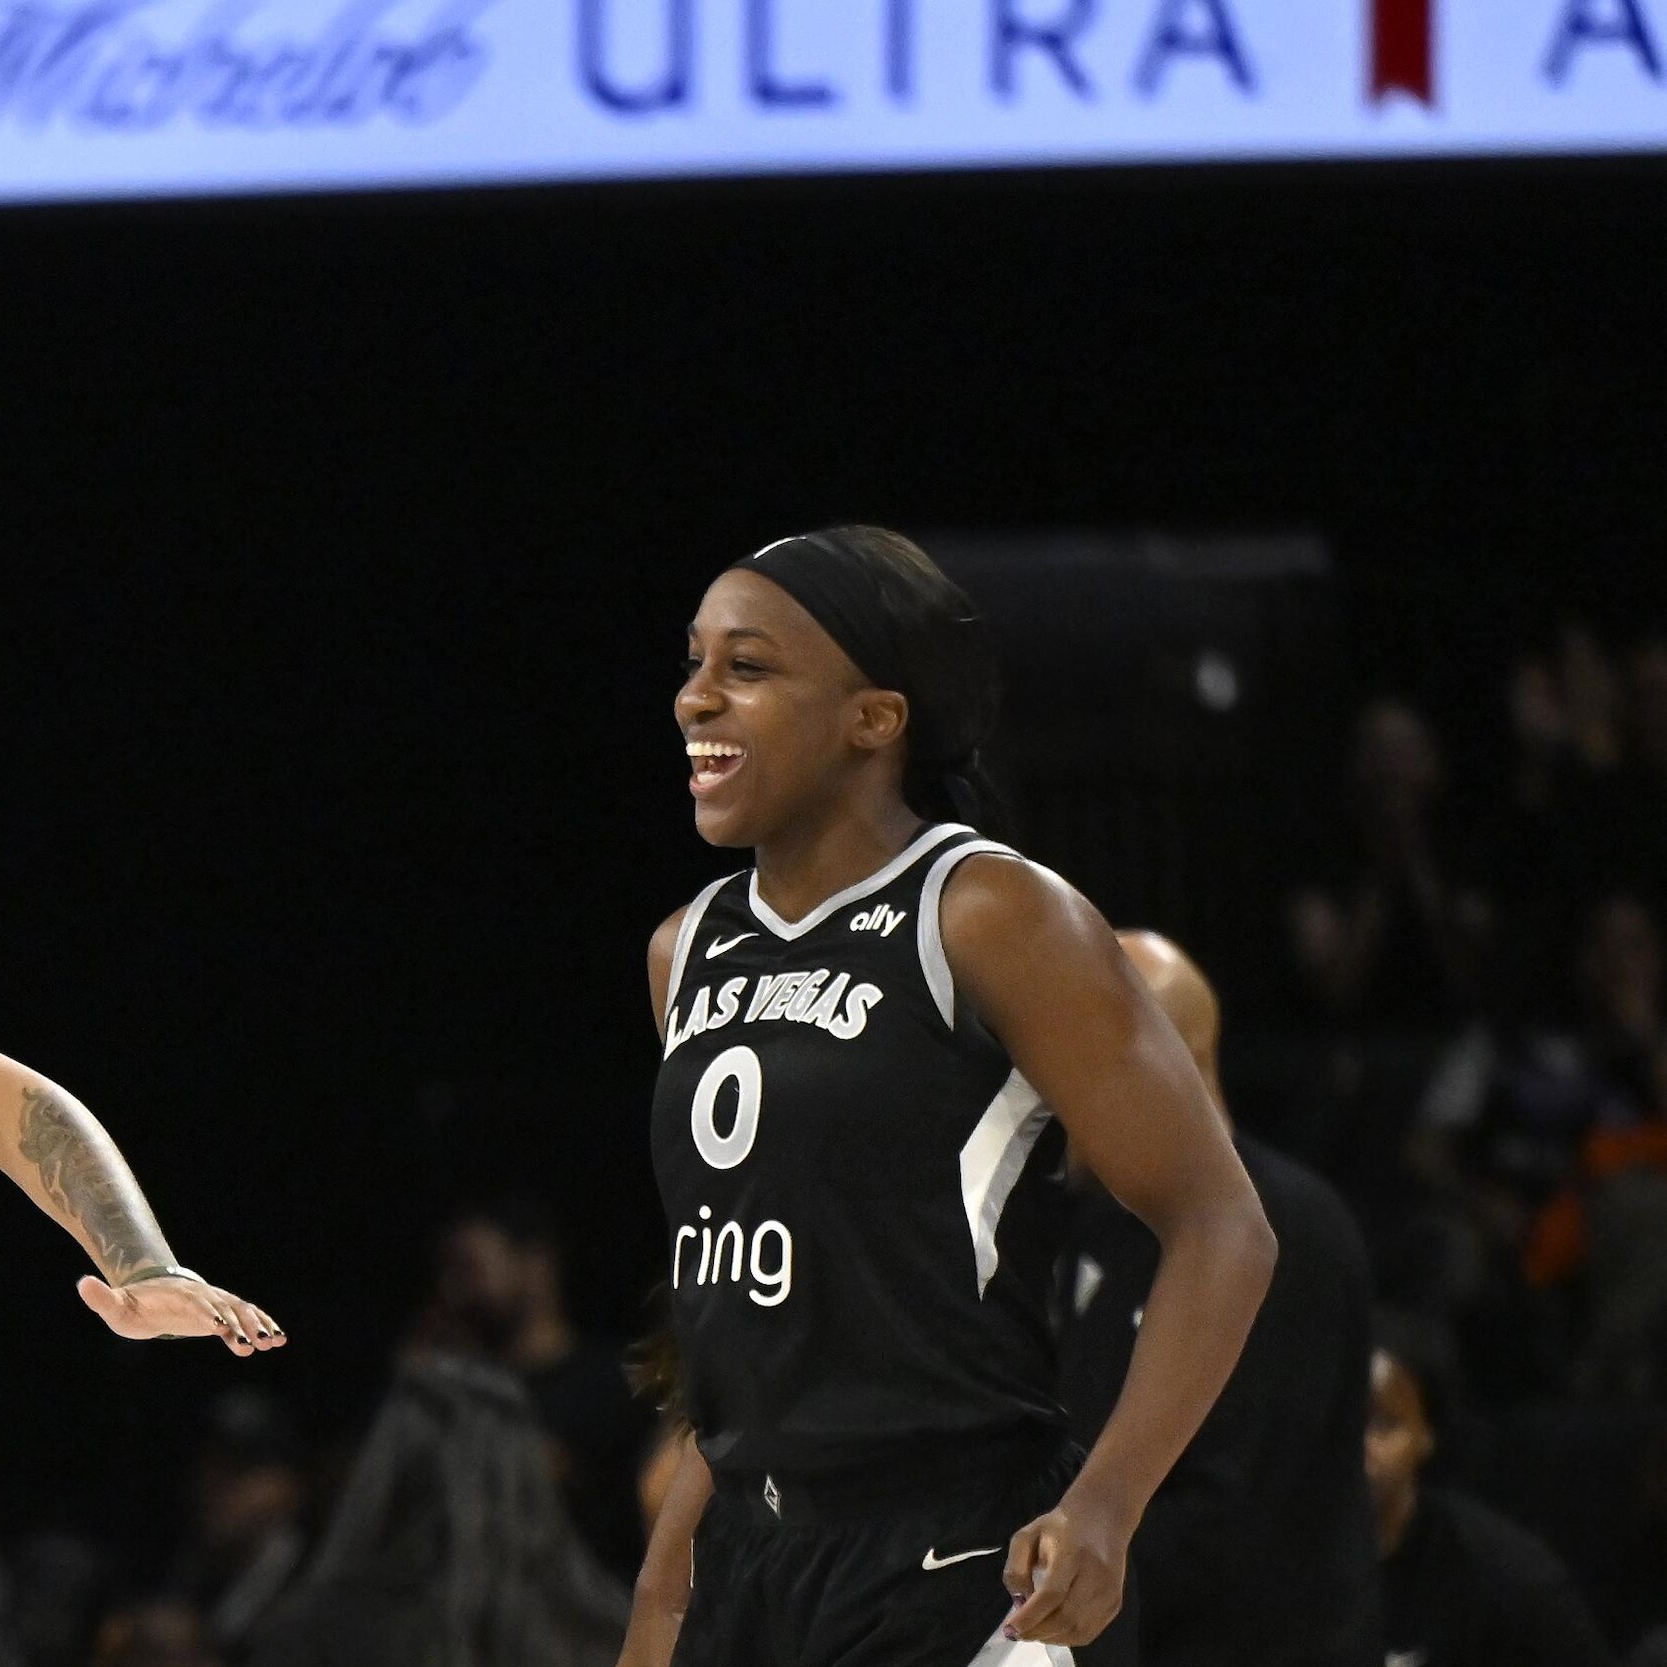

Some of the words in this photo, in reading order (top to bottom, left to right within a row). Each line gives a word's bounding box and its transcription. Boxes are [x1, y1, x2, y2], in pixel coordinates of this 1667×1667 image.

[849, 903, 906, 937] ally
[663, 976, 748, 1061] LAS
[743, 967, 884, 1040] VEGAS
[691, 1045, 762, 1170] 0
[673, 1205, 793, 1307] ring
